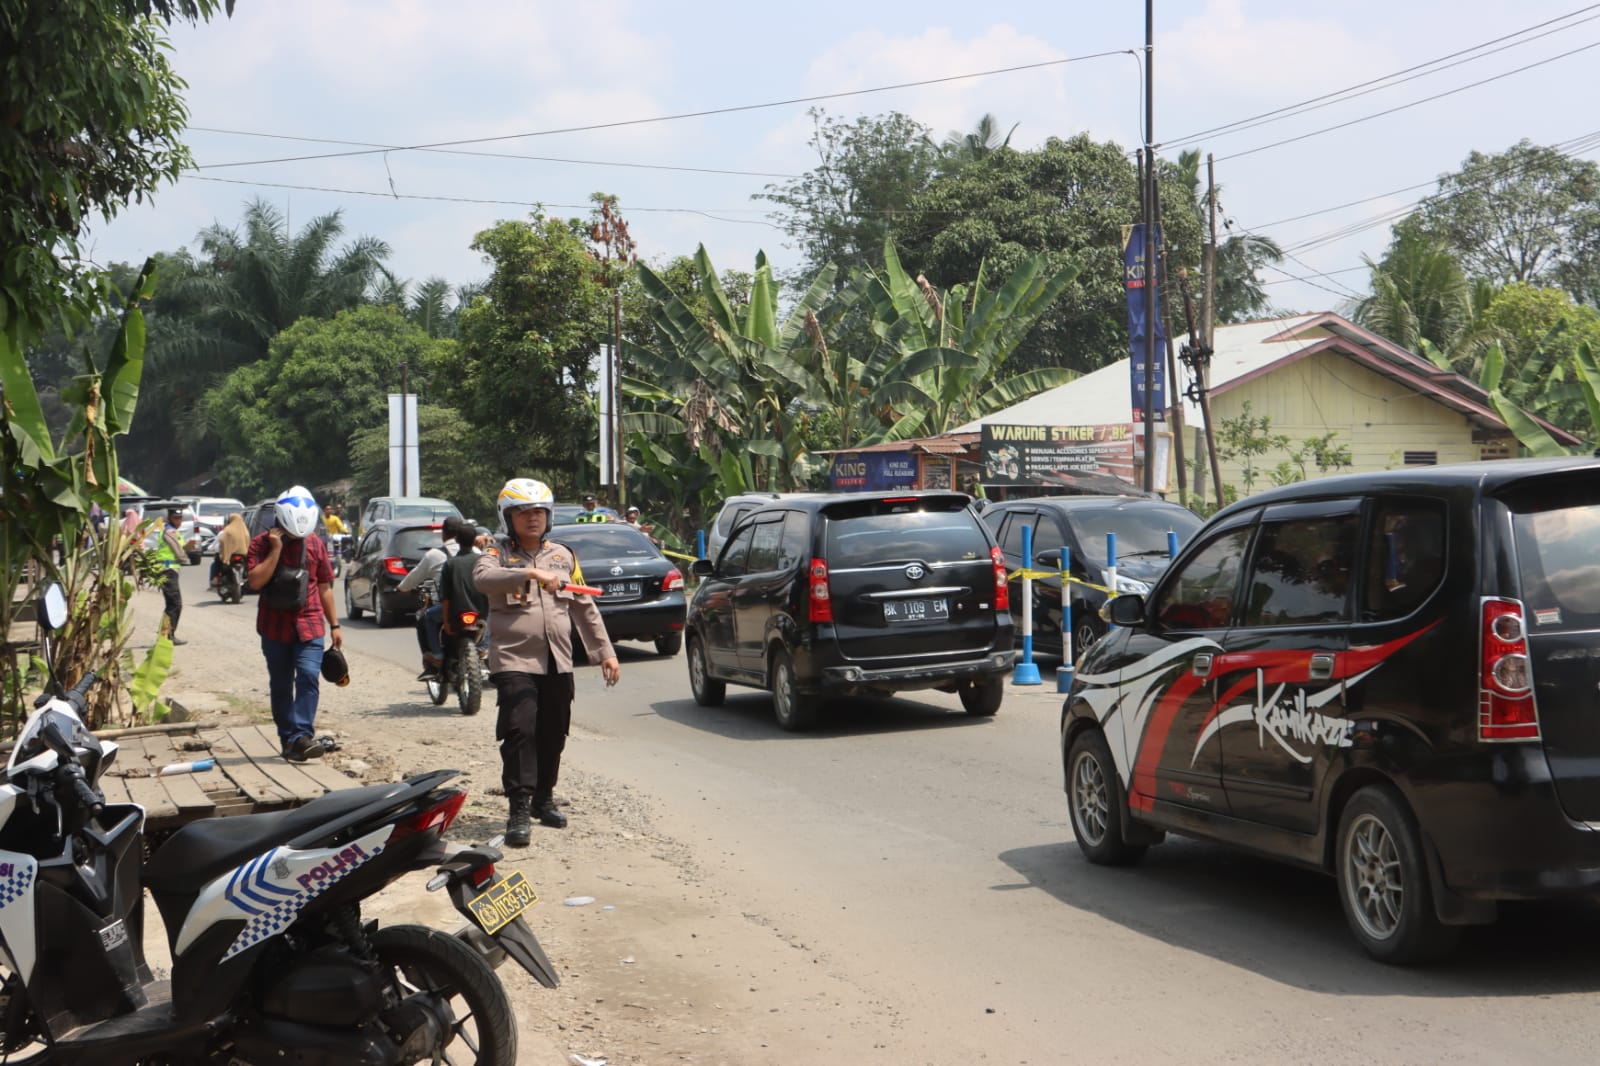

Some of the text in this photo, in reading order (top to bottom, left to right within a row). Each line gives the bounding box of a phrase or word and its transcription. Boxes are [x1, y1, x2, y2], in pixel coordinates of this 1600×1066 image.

[990, 425, 1046, 441] WARUNG
[1051, 425, 1095, 441] STIKER
[835, 462, 866, 477] KING
[884, 603, 897, 616] BK
[903, 601, 925, 614] 1109
[296, 843, 366, 889] POLISI
